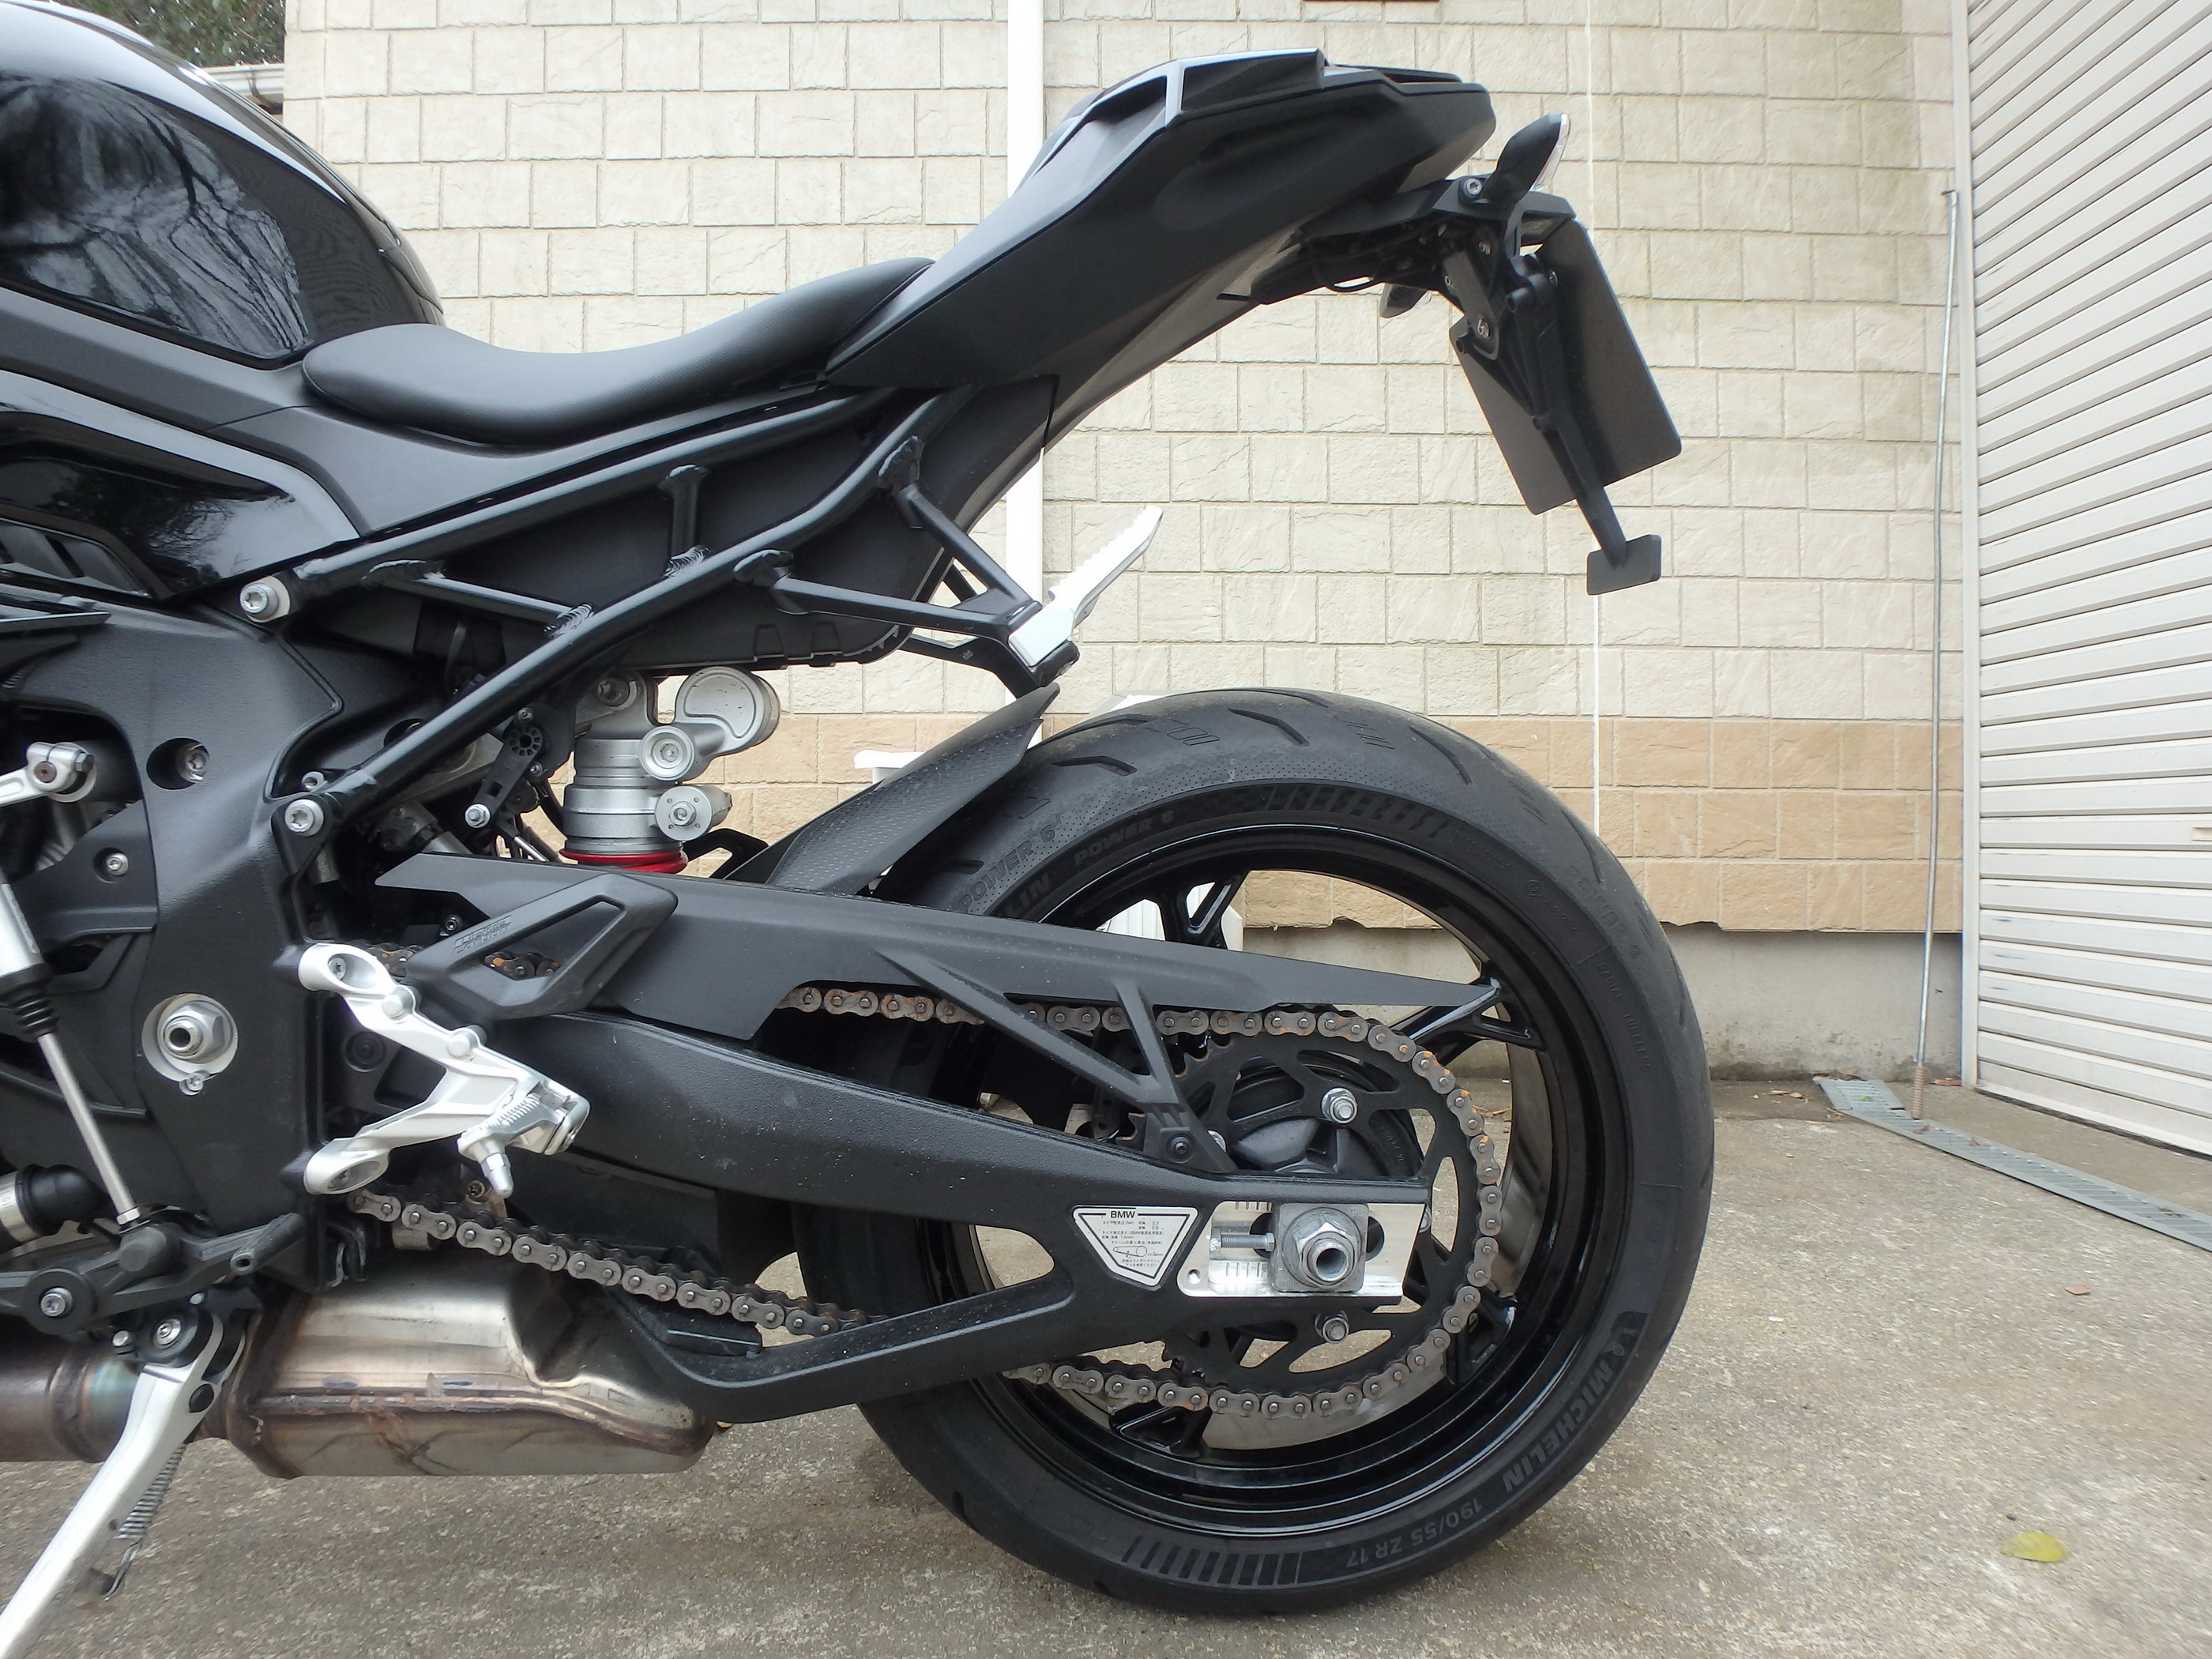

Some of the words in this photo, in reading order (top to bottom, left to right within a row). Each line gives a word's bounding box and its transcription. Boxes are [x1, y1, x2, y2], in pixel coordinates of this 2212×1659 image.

[1074, 818, 1152, 867] POWER
[1161, 810, 1175, 825] 6
[957, 841, 1033, 913] POWER
[1040, 823, 1055, 843] 6
[1110, 1210, 1136, 1219] BMW
[1503, 1360, 1613, 1493] MICHELIN
[1410, 1497, 1483, 1547] 190/55
[1345, 1548, 1369, 1568] 17
[1375, 1536, 1402, 1559] ZR
